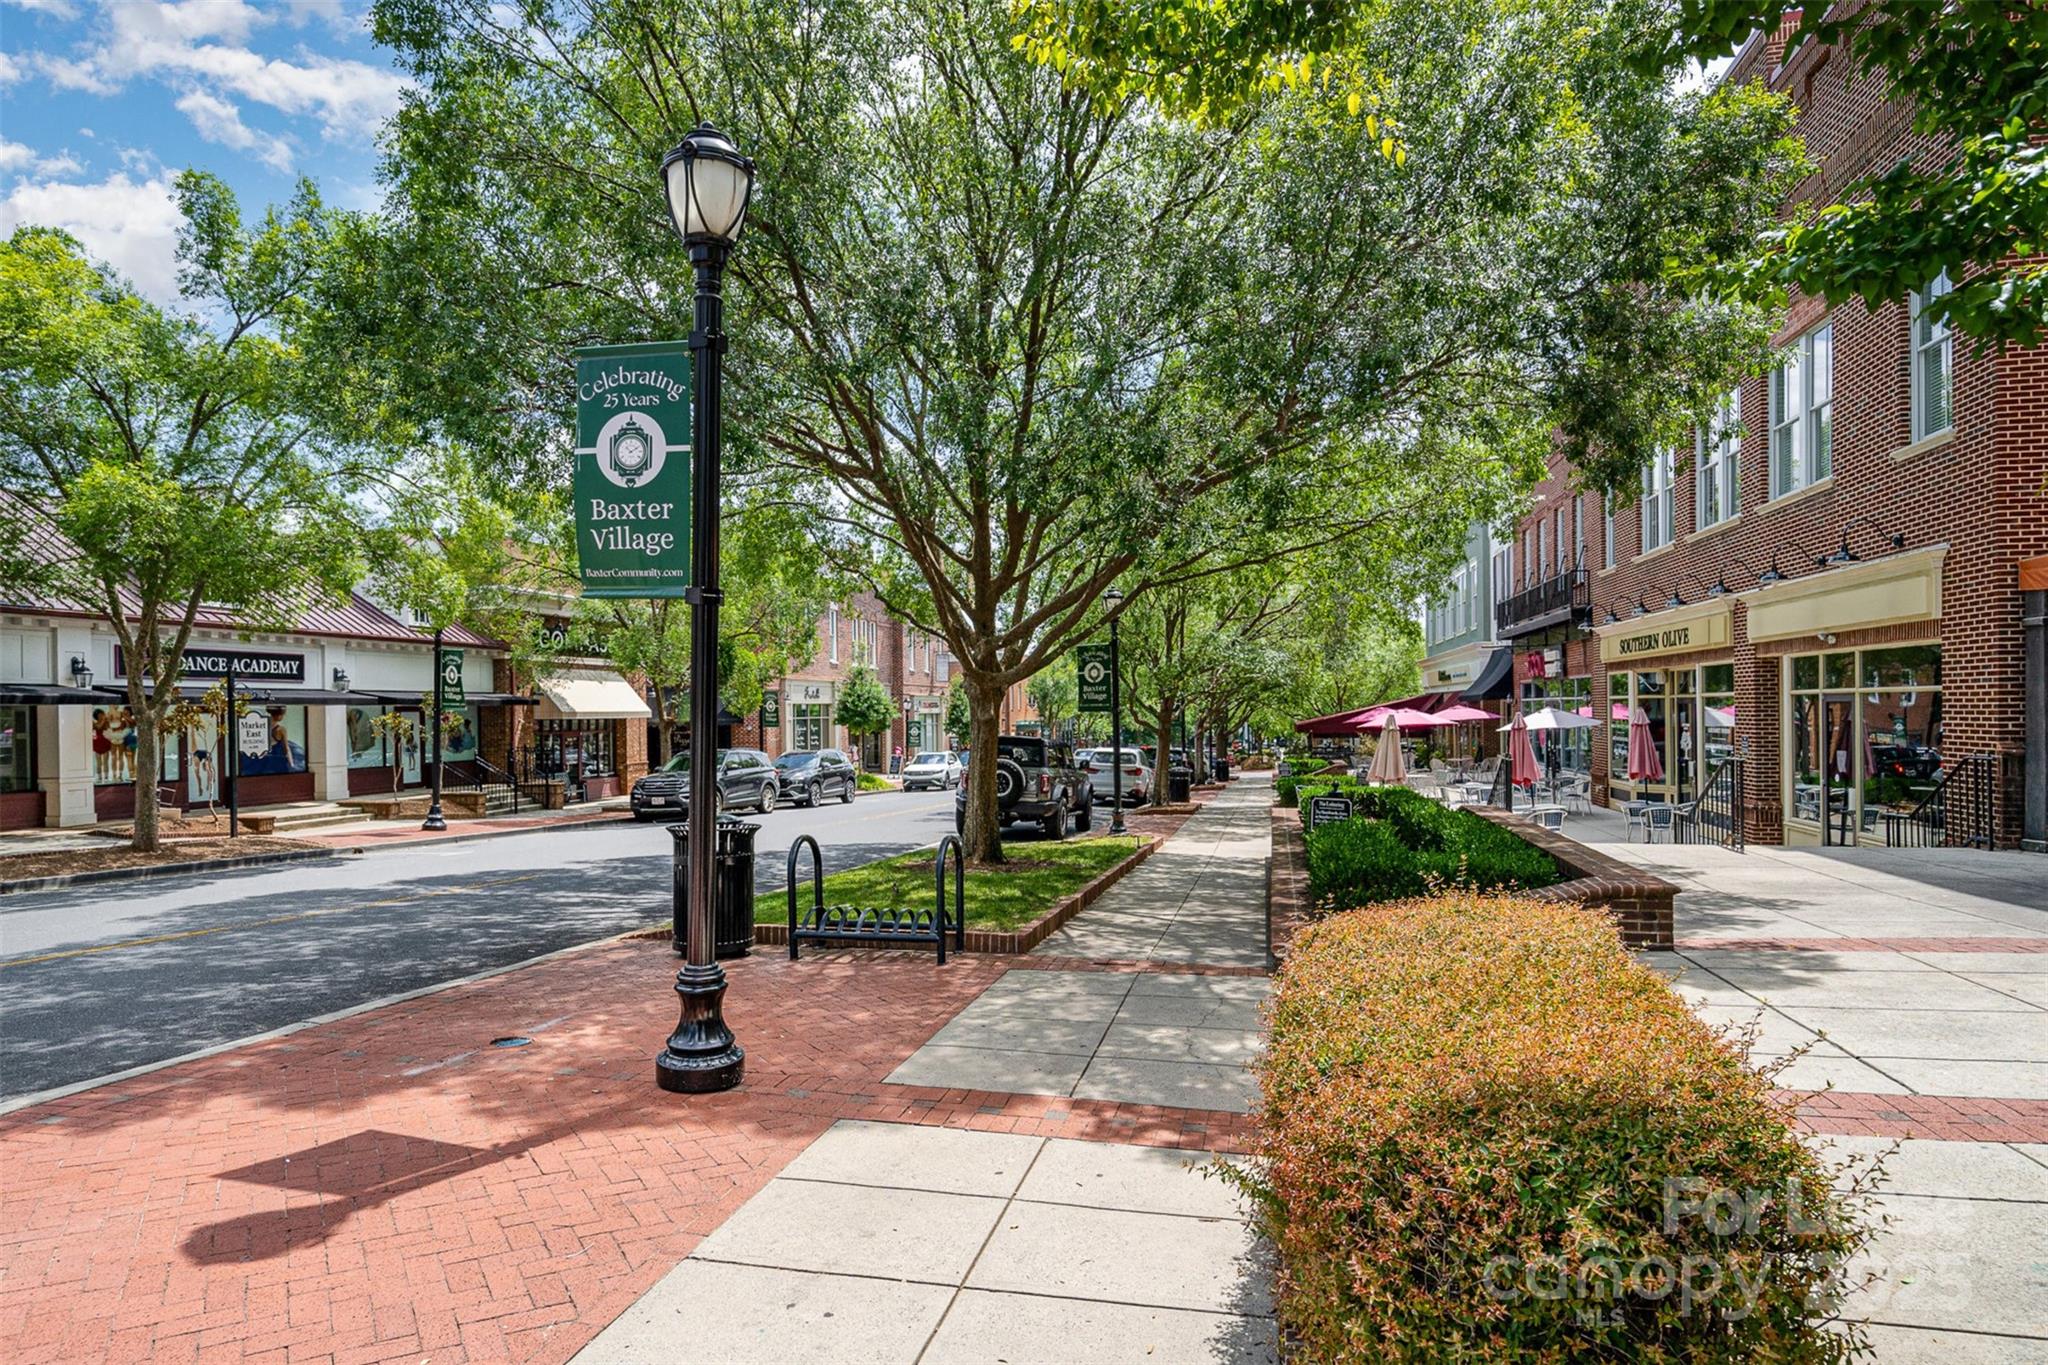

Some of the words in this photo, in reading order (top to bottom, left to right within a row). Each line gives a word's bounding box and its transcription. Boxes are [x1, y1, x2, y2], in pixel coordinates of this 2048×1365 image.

[579, 366, 686, 403] Celebrating
[603, 394, 618, 408] 25
[621, 392, 660, 407] Years
[590, 498, 673, 521] Baxter
[590, 525, 674, 556] Village
[585, 567, 684, 579] BaxterCommunity.com
[1619, 633, 1660, 654] SOUTHERN
[1662, 627, 1689, 647] OLIVE
[231, 658, 300, 674] ACADEMY
[1083, 692, 1108, 701] Village
